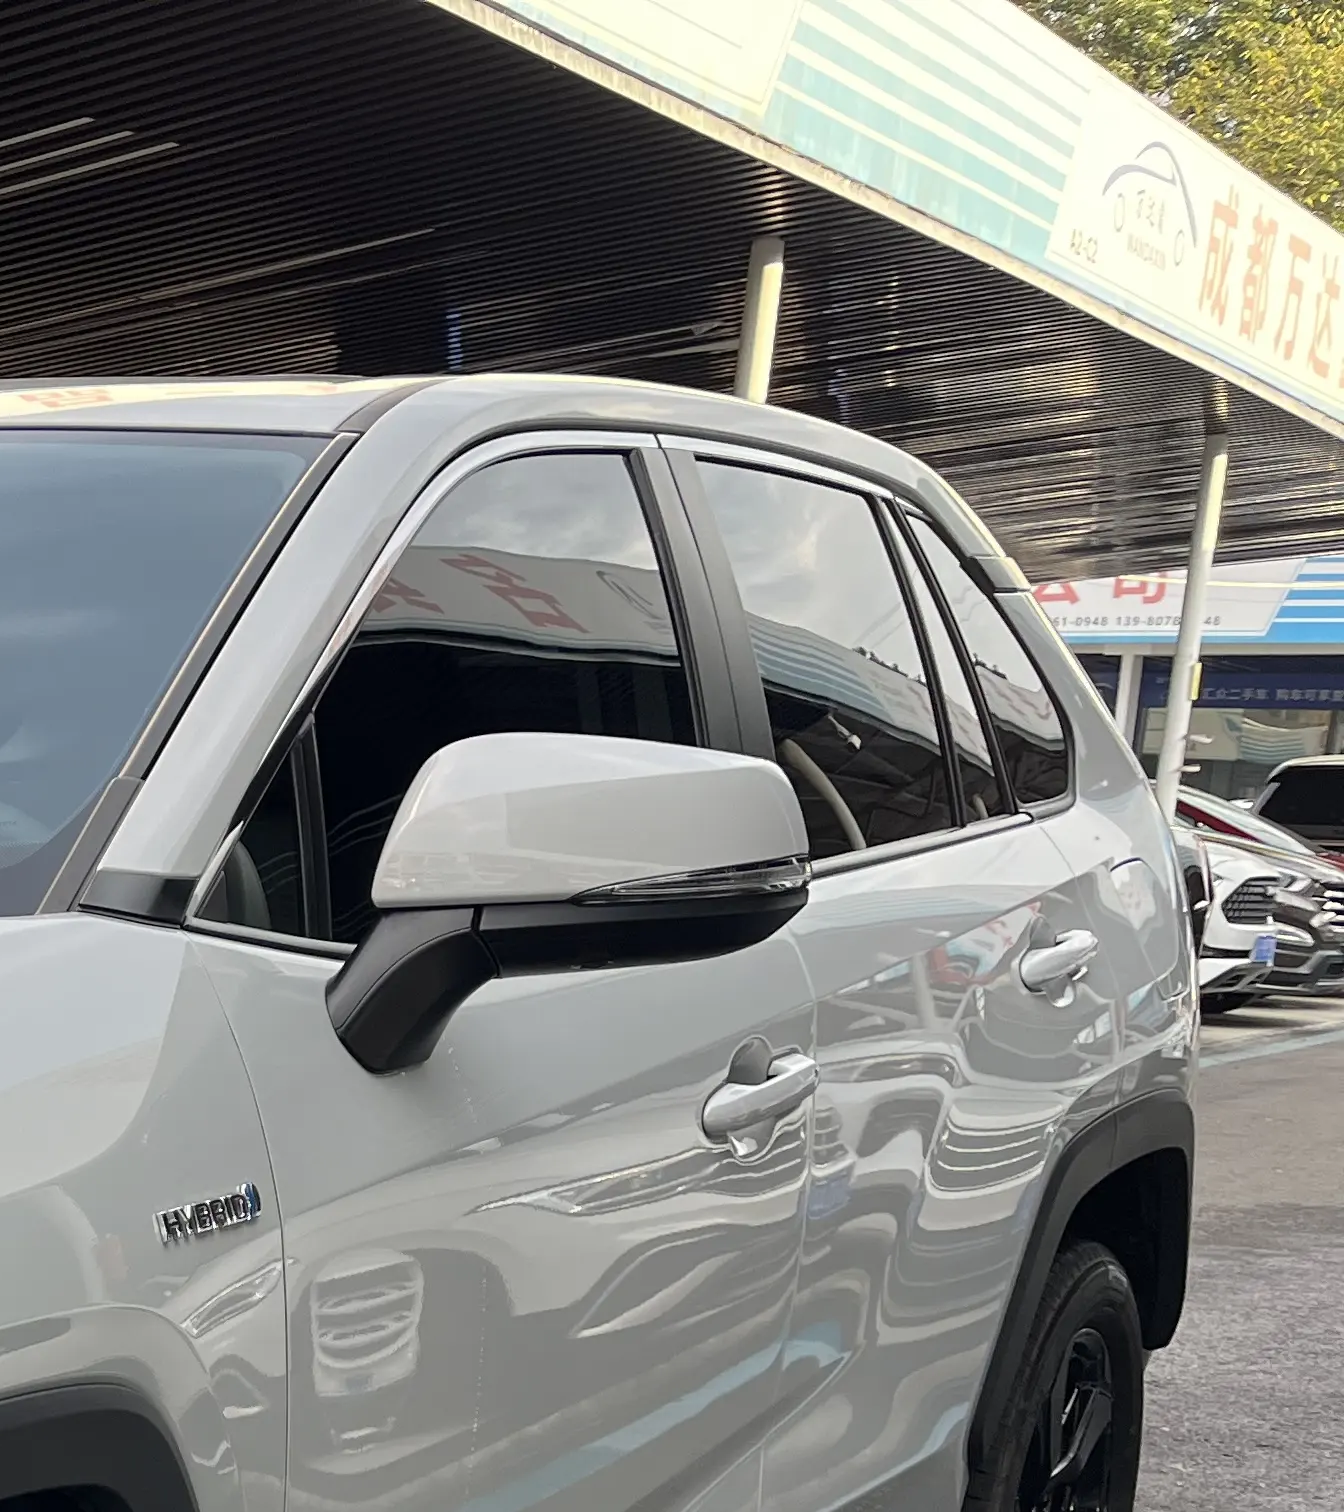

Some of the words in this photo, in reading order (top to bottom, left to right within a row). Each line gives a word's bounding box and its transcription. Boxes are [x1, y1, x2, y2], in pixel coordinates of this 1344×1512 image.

[1198, 183, 1344, 390] 成都万达
[155, 1193, 252, 1244] HYBRID
